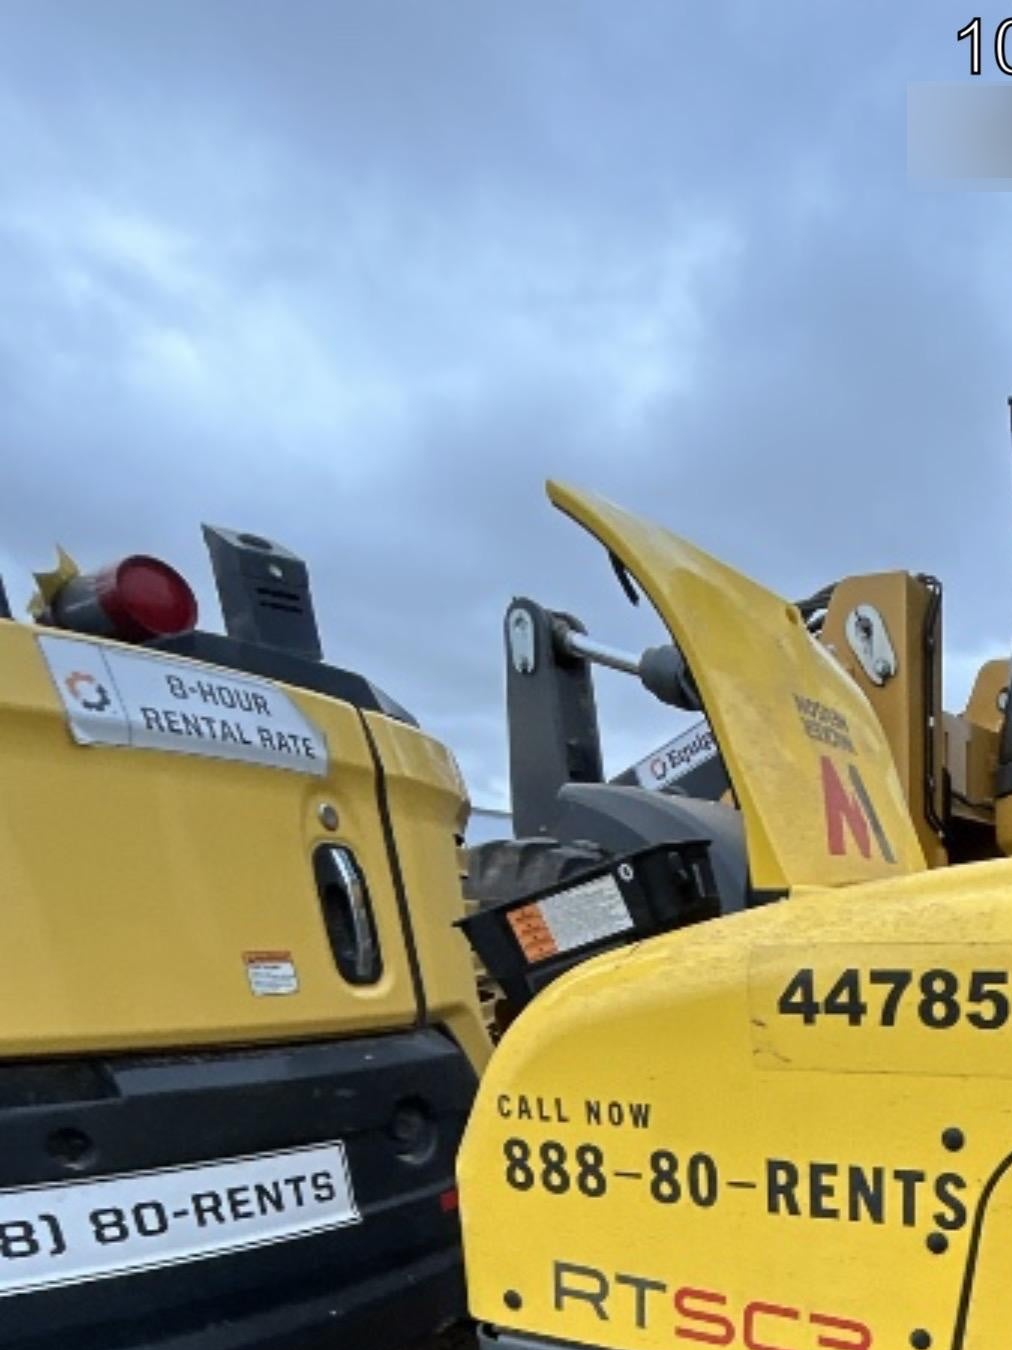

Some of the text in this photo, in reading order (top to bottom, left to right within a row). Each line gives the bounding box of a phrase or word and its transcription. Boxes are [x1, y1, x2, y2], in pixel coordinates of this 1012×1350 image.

[166, 674, 272, 717] 8-HOUR
[140, 706, 317, 760] RENTAL RATE
[497, 1094, 651, 1129] CALL NOW
[89, 1171, 336, 1245] 80-RENTS
[503, 1137, 967, 1231] 888-80-RENTS
